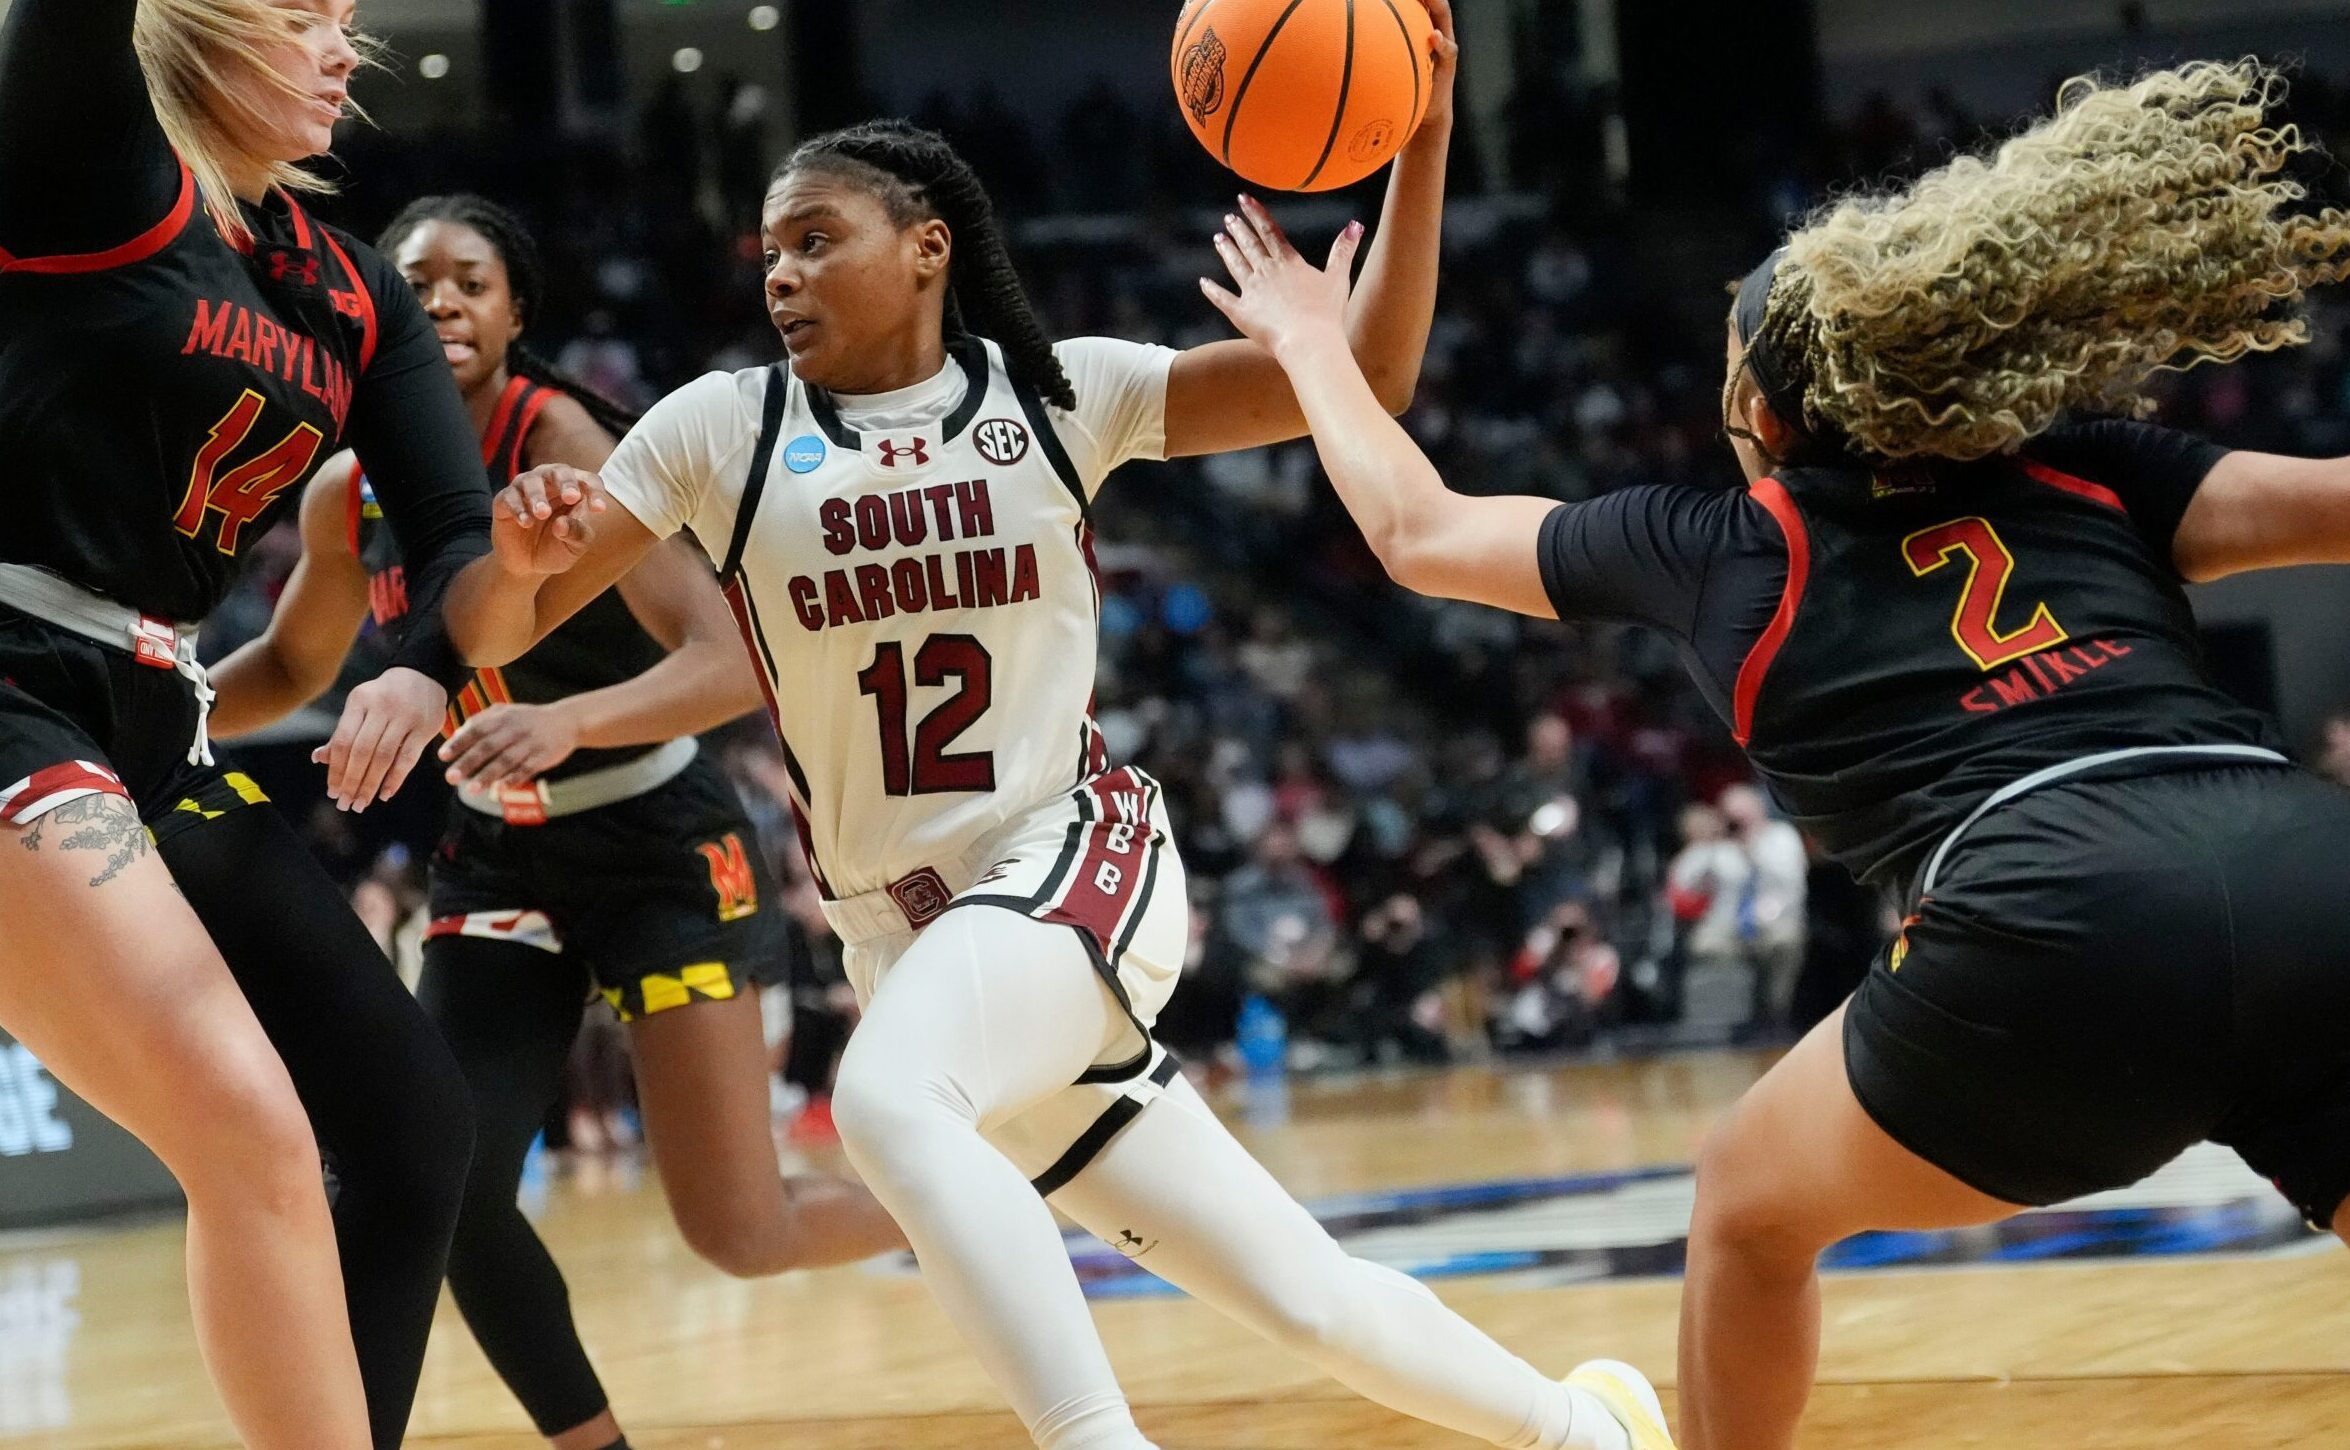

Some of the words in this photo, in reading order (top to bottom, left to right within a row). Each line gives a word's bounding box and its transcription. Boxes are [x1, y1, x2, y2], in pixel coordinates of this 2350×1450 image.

[1194, 40, 1225, 103] MADNESS
[181, 299, 352, 443] MARYLAN
[173, 388, 323, 556] 14
[979, 421, 1025, 460] SEC
[819, 479, 994, 555] SOUTH
[787, 543, 1040, 632] CAROLINA
[1902, 516, 2069, 672] 2
[857, 633, 996, 797] 12
[1960, 639, 2132, 713] SMIKLE
